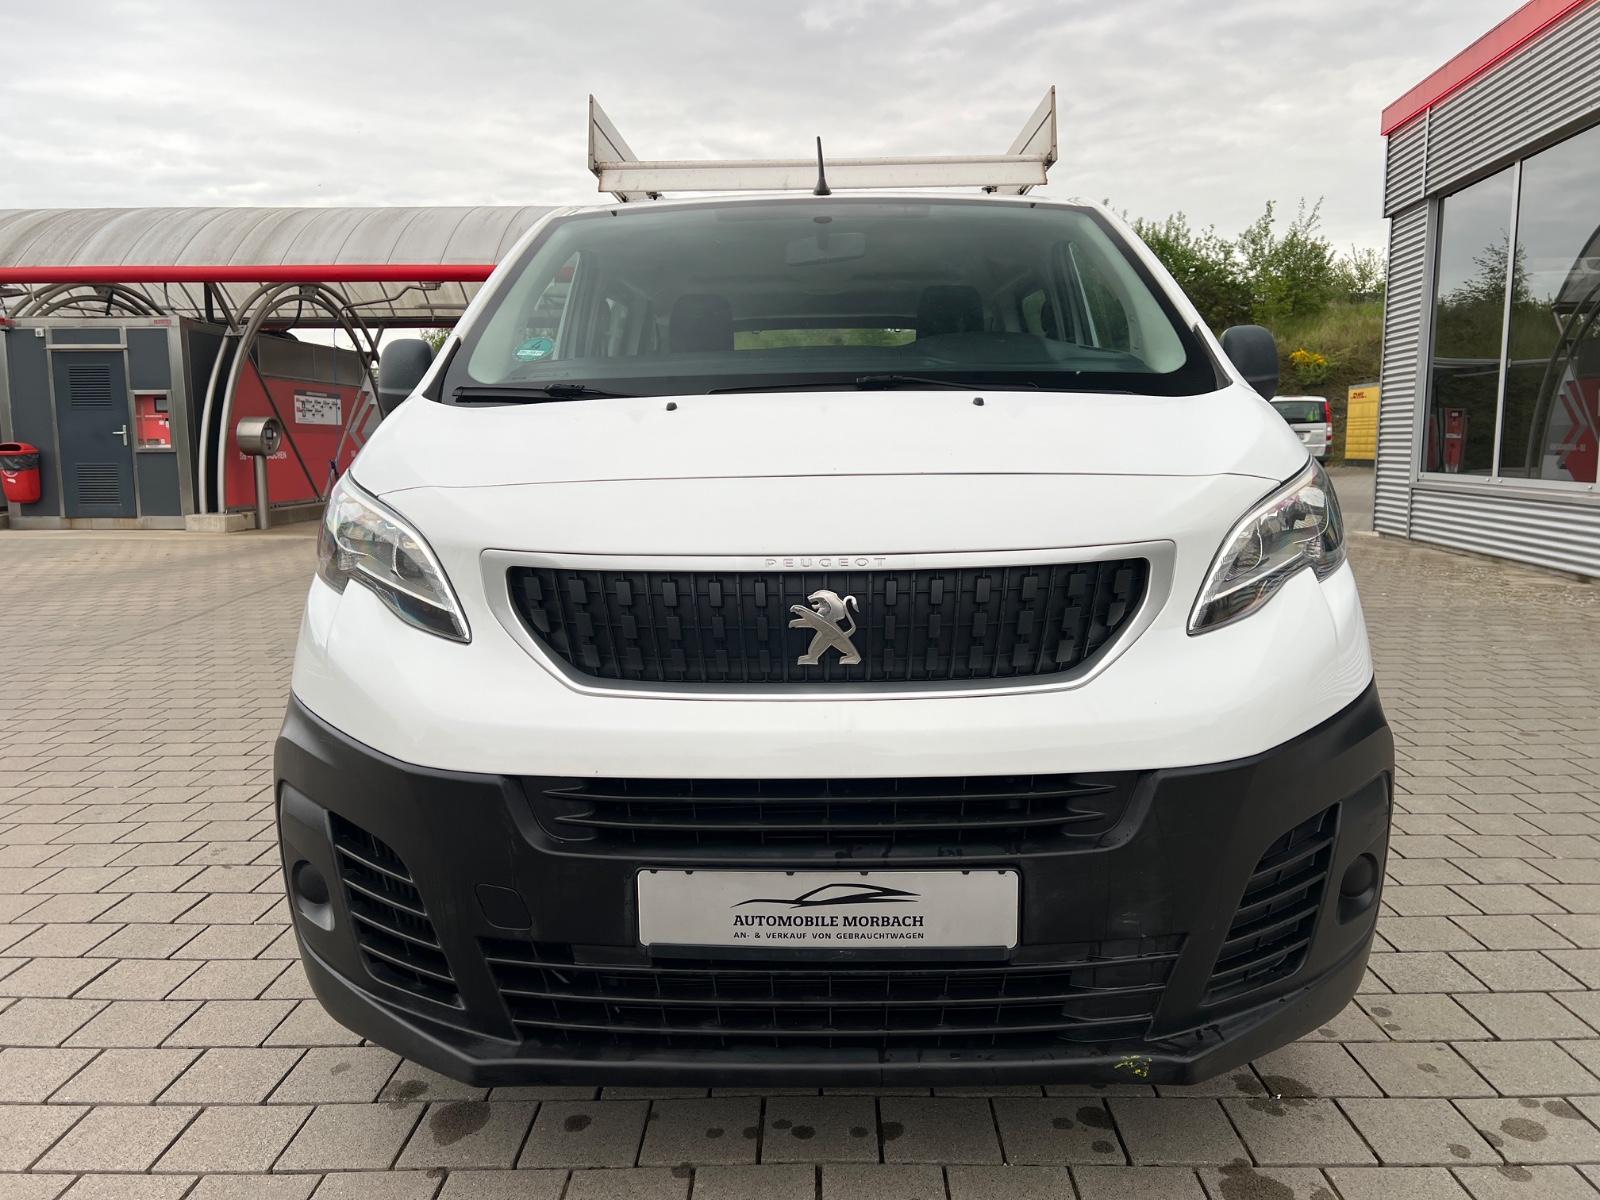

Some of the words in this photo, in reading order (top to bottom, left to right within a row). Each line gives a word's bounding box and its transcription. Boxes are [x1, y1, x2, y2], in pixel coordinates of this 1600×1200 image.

[765, 557, 887, 568] PEUGEOT
[733, 914, 839, 927] AUTOMOBILE
[842, 914, 924, 927] MORBACH
[754, 932, 761, 940] &
[765, 932, 808, 940] VERKAUF
[811, 932, 832, 940] VON
[836, 932, 925, 940] GEBRAUCHTWAGEN
